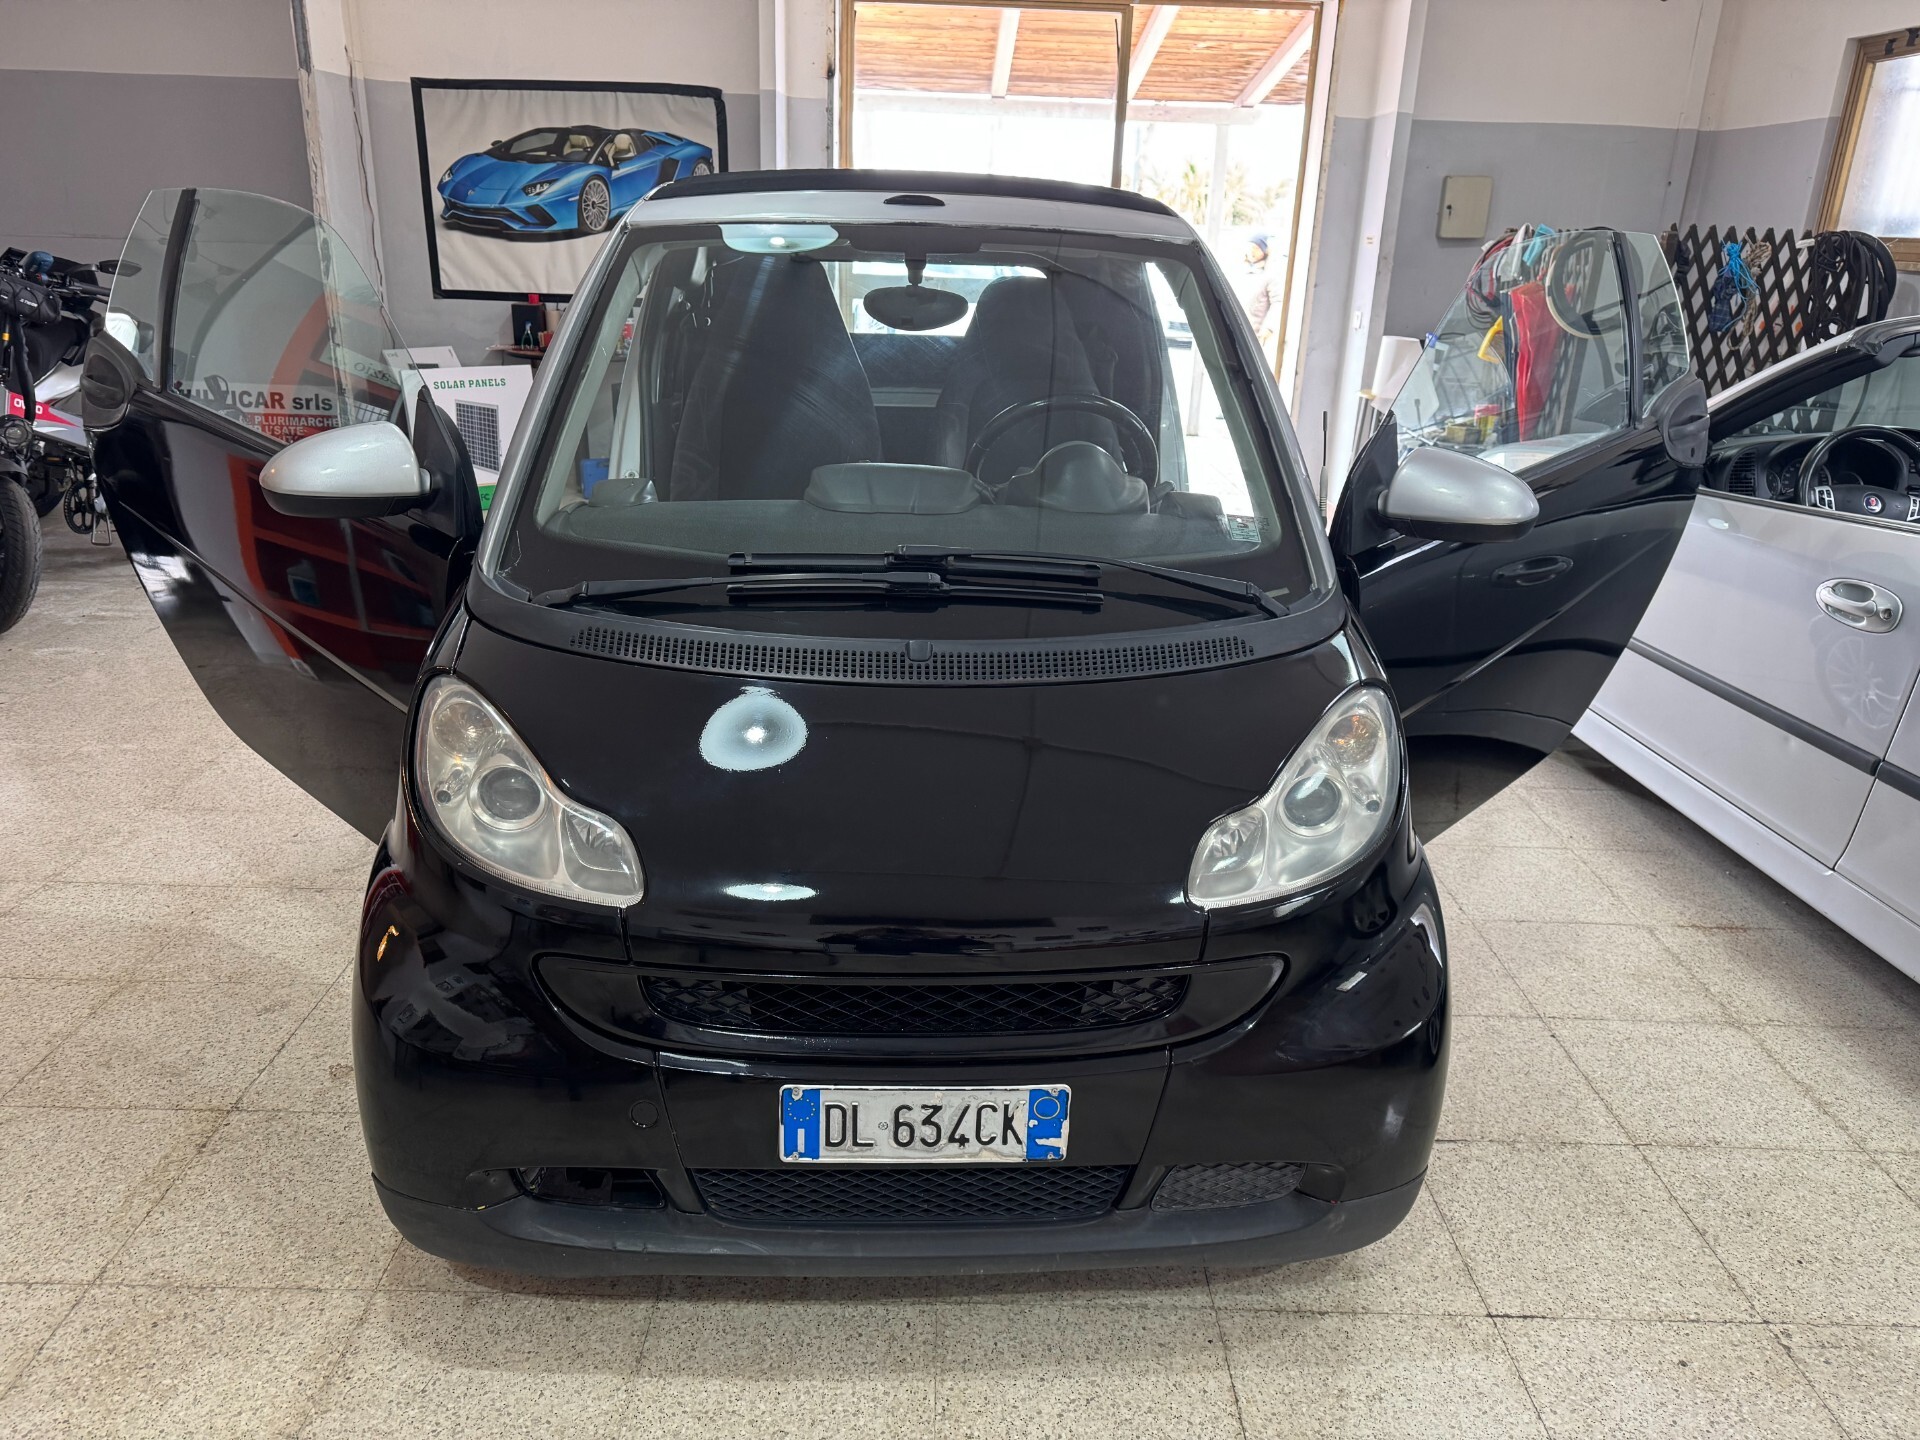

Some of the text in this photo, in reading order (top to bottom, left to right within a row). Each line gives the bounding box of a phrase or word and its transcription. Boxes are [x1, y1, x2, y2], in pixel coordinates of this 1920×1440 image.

[433, 378, 506, 390] SOLAR PANELS
[292, 393, 333, 411] srls
[254, 415, 340, 428] PLURIMARCHE
[824, 1100, 1027, 1148] DL 634CK
